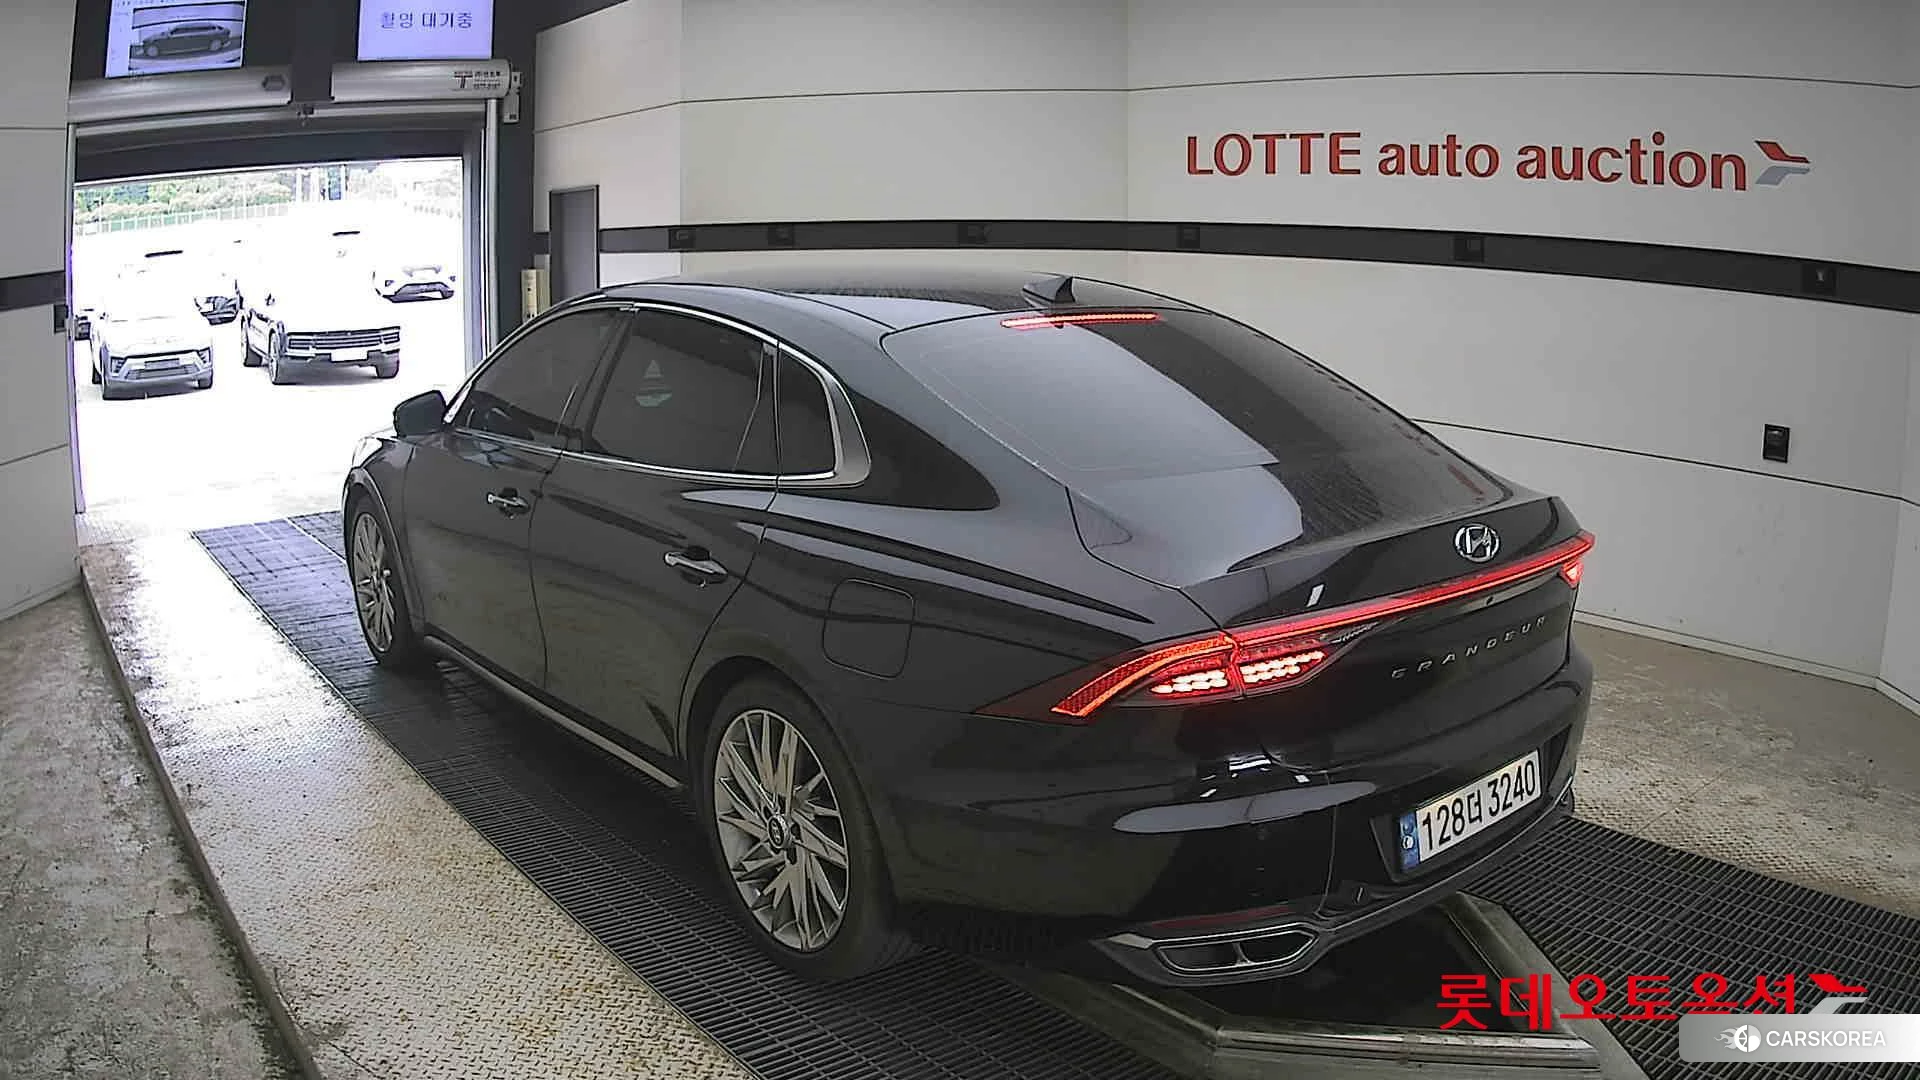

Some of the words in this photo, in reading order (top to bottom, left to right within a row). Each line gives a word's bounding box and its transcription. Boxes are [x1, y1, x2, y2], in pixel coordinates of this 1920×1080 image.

[422, 12, 472, 29] 대기중
[1187, 131, 1361, 176] LOTTE
[1378, 134, 1500, 178] auto
[1516, 131, 1747, 191] auction
[1391, 616, 1545, 679] GRANDEUR
[1488, 760, 1536, 819] 3240
